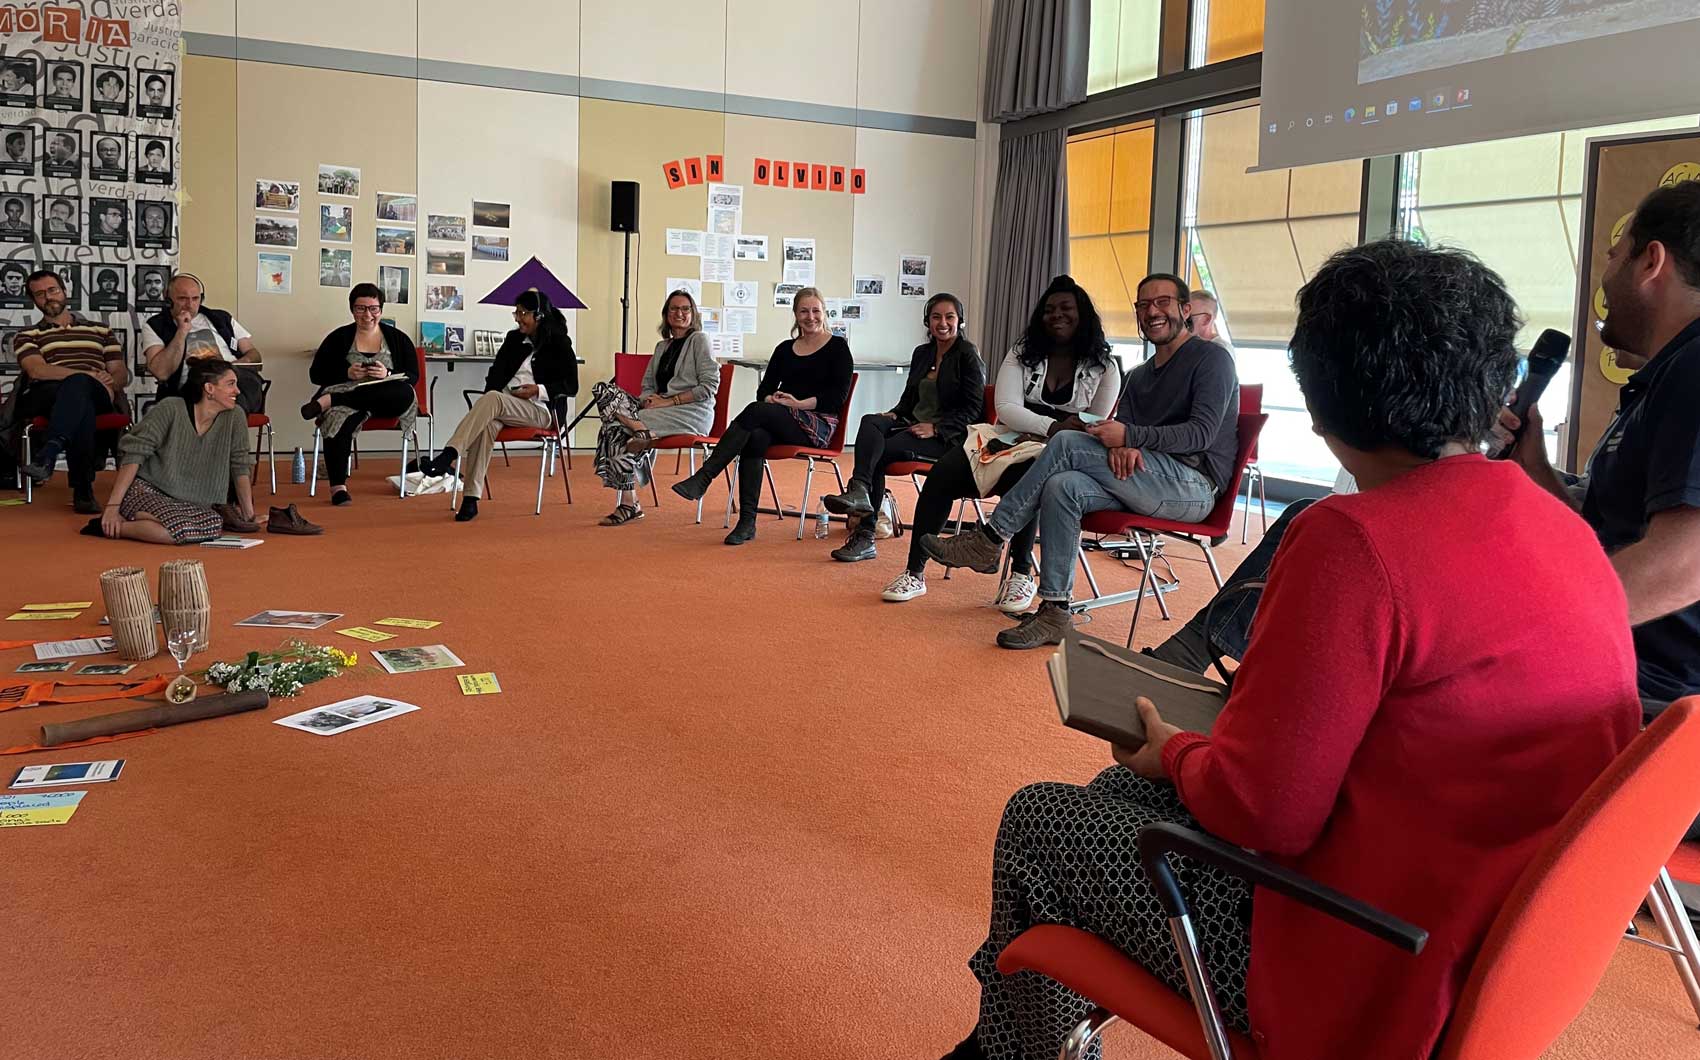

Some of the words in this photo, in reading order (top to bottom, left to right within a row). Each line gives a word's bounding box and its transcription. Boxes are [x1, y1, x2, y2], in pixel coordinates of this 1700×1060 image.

[669, 160, 720, 184] SIN
[757, 164, 863, 189] OLVIDO
[88, 181, 147, 200] verdad
